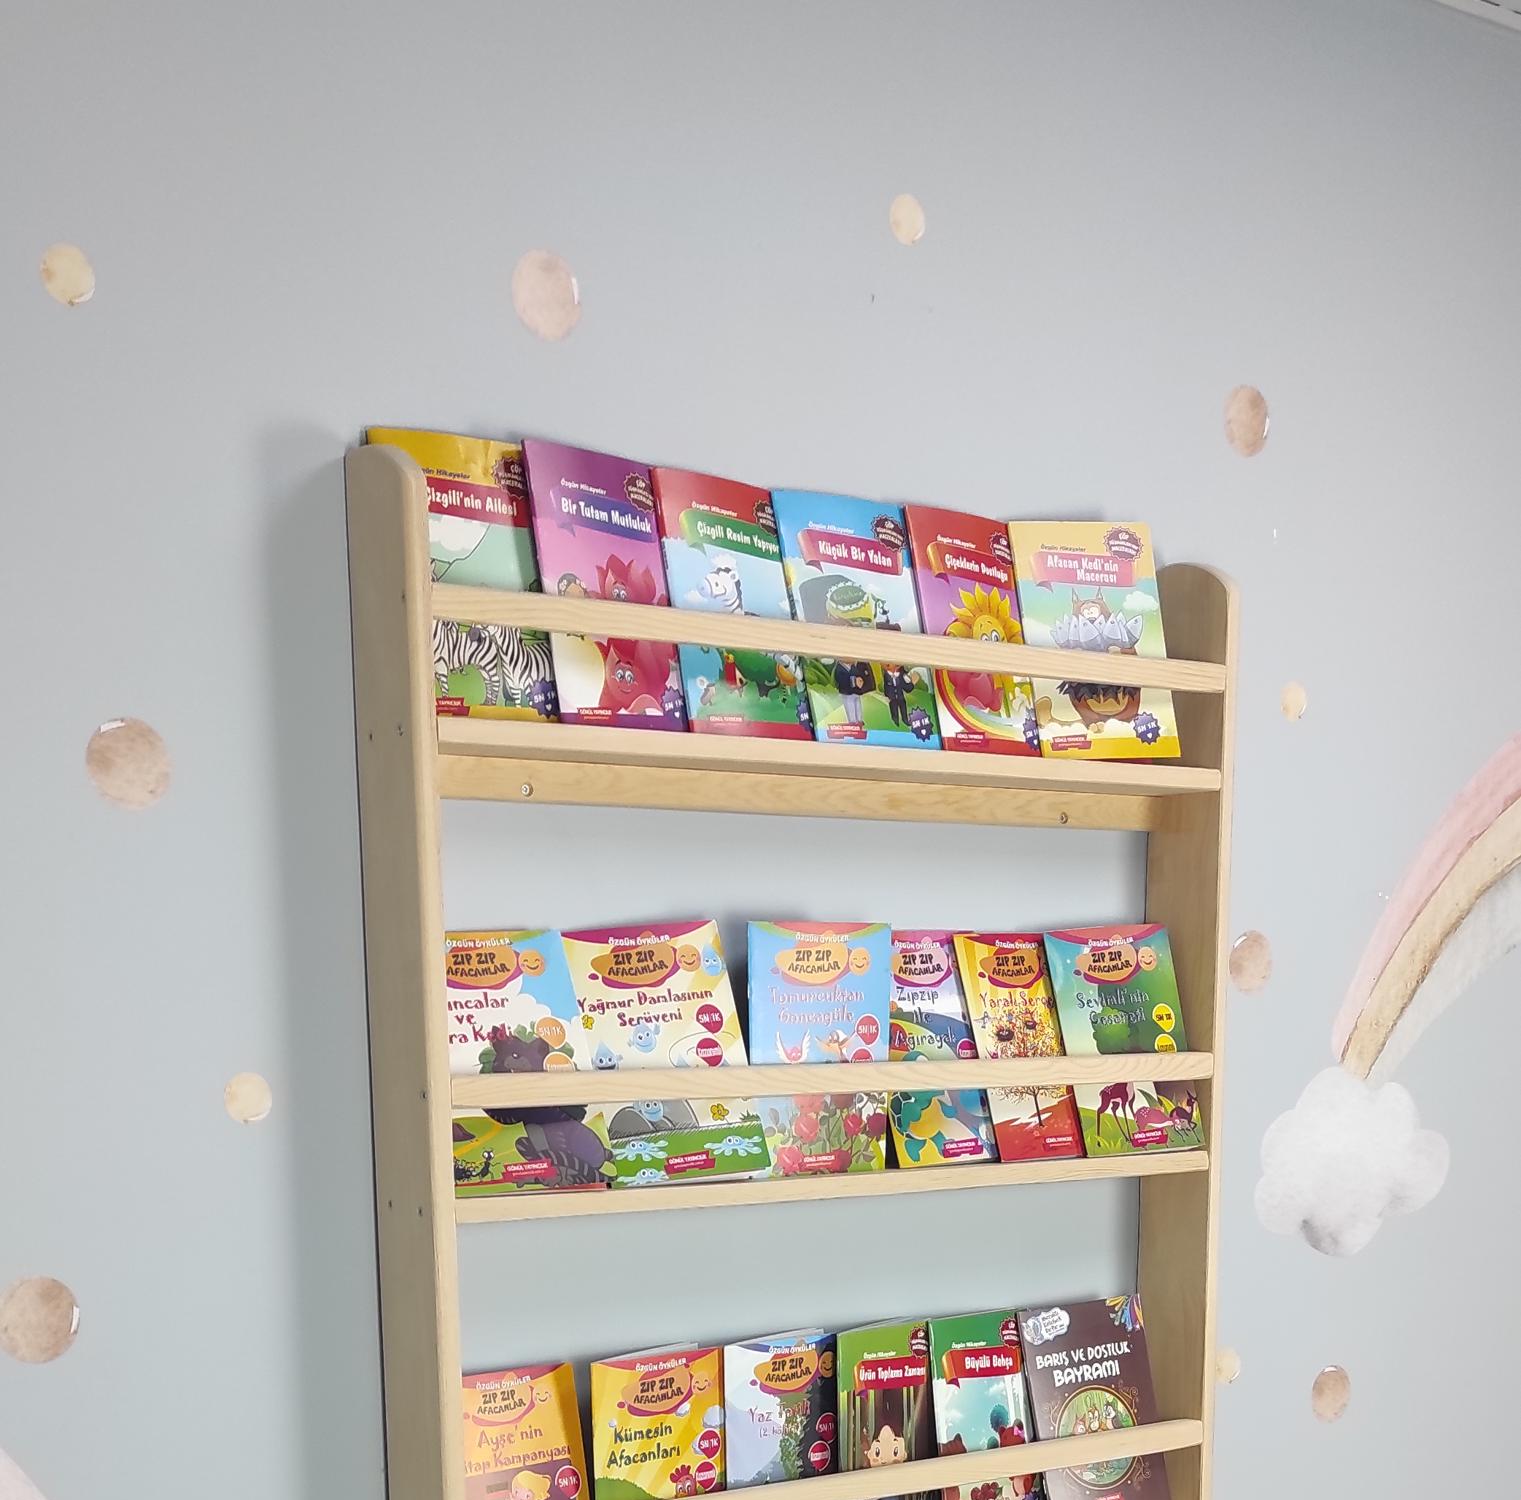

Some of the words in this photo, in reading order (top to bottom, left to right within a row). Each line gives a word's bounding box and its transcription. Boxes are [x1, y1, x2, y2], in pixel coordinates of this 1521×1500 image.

[485, 496, 517, 518] Ailesi
[561, 497, 577, 516] Bir
[578, 501, 609, 523] Tutam
[611, 510, 652, 534] Mutluluk
[697, 520, 725, 540] Çizgili
[726, 527, 751, 546] Resim
[752, 534, 780, 555] Yapıyor
[818, 540, 849, 561] Küçük
[850, 545, 866, 562] Bir
[867, 549, 893, 568] Yalan
[1046, 555, 1080, 571] Afacan
[1081, 556, 1119, 573] Kedi'nin
[1076, 569, 1118, 584] Macerası
[608, 937, 635, 947] ÖZGÜN
[636, 934, 671, 947] ÖYKÜLER
[451, 953, 473, 966] ZIP
[475, 952, 497, 965] ZIP
[612, 952, 634, 966] ZIP
[635, 950, 656, 963] ZIP
[795, 950, 813, 962] ZIP
[815, 949, 832, 962] ZIP
[901, 954, 917, 966] ZIP
[919, 953, 934, 965] ZIP
[995, 956, 1010, 967] ZIP
[1011, 955, 1025, 967] ZIP
[1091, 951, 1106, 964] ZIP
[1108, 950, 1123, 962] ZIP
[446, 963, 512, 978] AFACANLAR
[607, 960, 669, 978] AFACANLAR
[788, 961, 841, 974] AFACANLAR
[898, 963, 945, 977] AFACANLAR
[992, 965, 1036, 977] AFACANLAR
[1087, 960, 1133, 974] AFACANLAR
[447, 991, 510, 1012] ıncalar
[577, 997, 635, 1015] Yağmur
[636, 988, 714, 1006] Damlasının
[768, 984, 865, 1005] Tomurcuktan
[979, 991, 1018, 1009] Yaralı
[454, 1013, 477, 1025] ve
[616, 1008, 683, 1028] Serüveni
[448, 1033, 469, 1045] ra
[768, 1345, 790, 1355] ÖZGÜN
[789, 1342, 816, 1353] ÖYKÜLER
[1035, 1351, 1070, 1370] BARIŞ
[1070, 1348, 1086, 1363] VE
[1087, 1341, 1131, 1361] DOSTLUK
[635, 1361, 658, 1372] ÖZGÜN
[658, 1357, 687, 1370] ÖYKÜLER
[771, 1360, 787, 1372] ZIP
[788, 1356, 804, 1370] ZIP
[964, 1355, 991, 1373] Büyülü
[765, 1366, 812, 1383] AFACANLAR
[859, 1365, 876, 1381] Ürün
[877, 1366, 903, 1380] Toplama
[1052, 1360, 1120, 1388] BAYRAMI
[476, 1381, 500, 1391] ÖZGÜN
[500, 1375, 531, 1389] ÖYKÜLER
[640, 1380, 656, 1393] ZIP
[658, 1376, 675, 1390] ZIP
[482, 1392, 498, 1405] ZIP
[500, 1389, 517, 1402] ZIP
[633, 1387, 684, 1404] AFACANLAR
[477, 1398, 527, 1416] AFACANLAR
[749, 1406, 773, 1424] Yaz
[477, 1424, 543, 1452] Ayşe'nin
[613, 1422, 673, 1444] Kümesin
[464, 1459, 491, 1475] itap
[493, 1445, 571, 1468] Kampanyası
[606, 1442, 681, 1469] Afacanları
